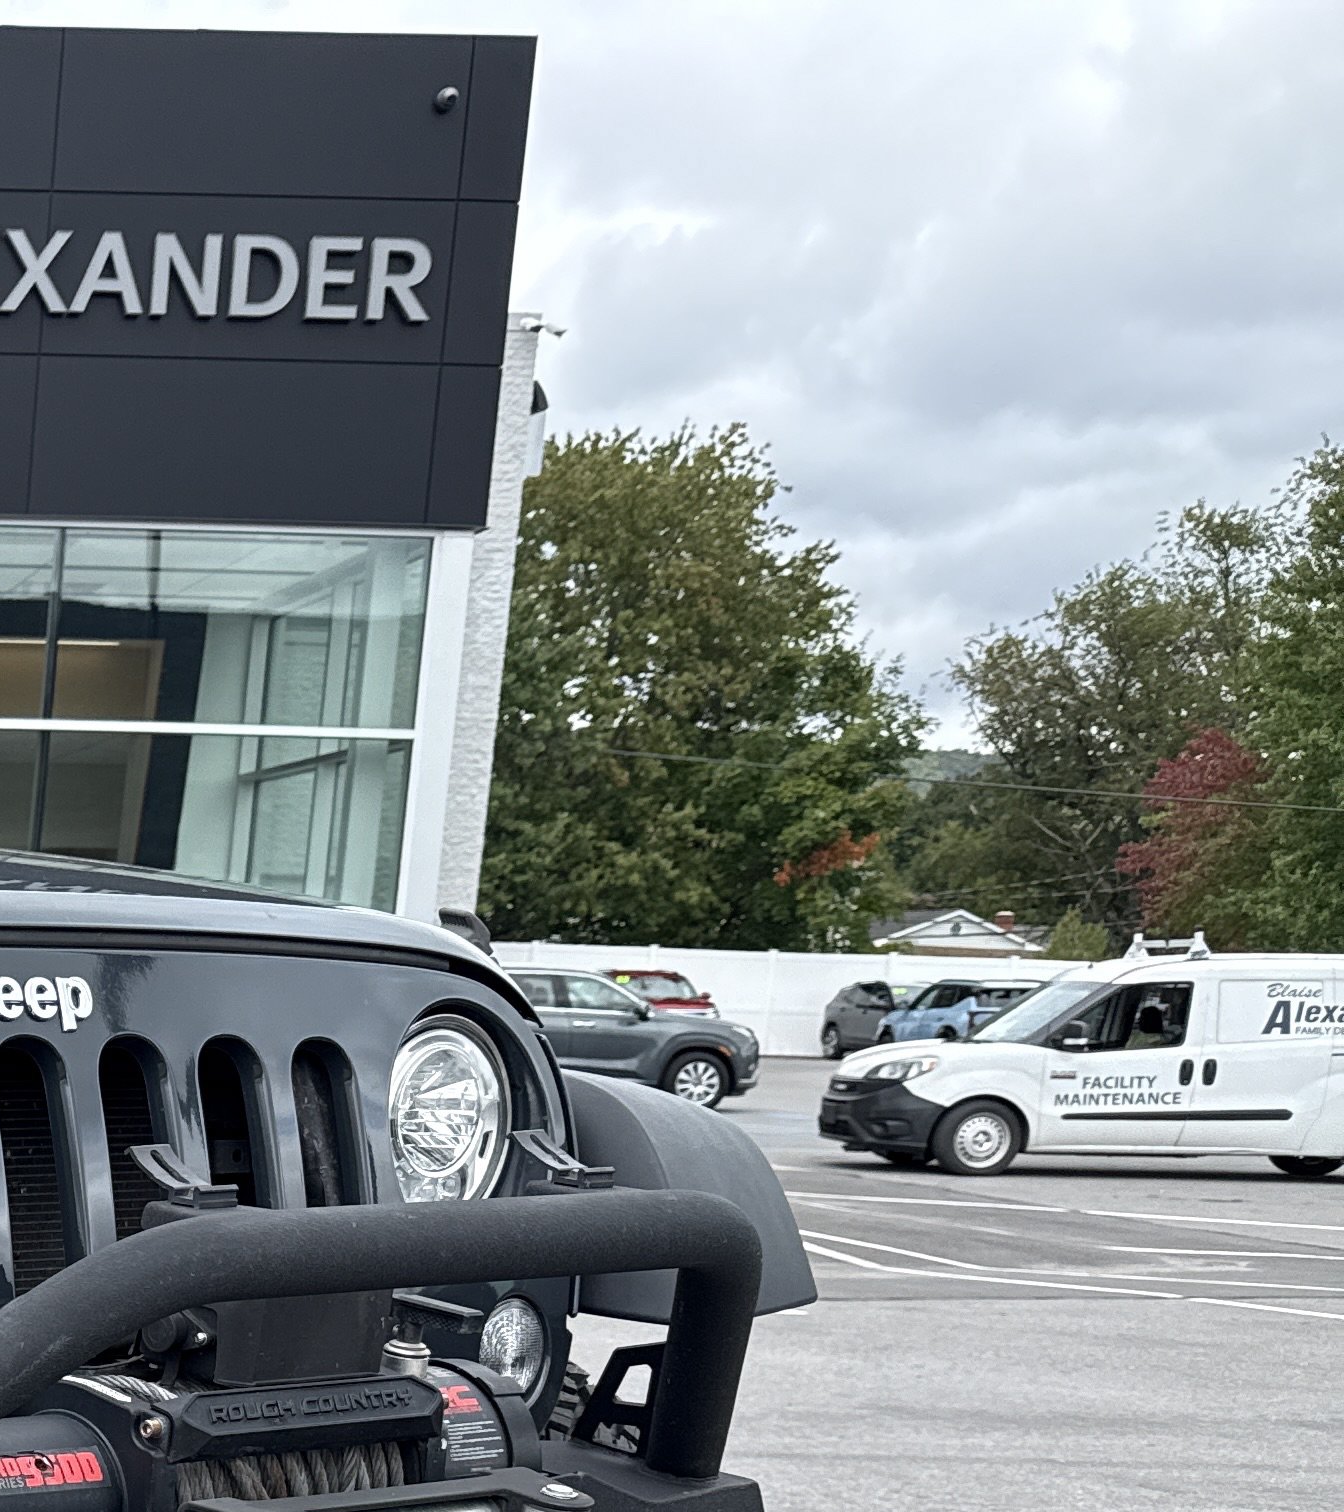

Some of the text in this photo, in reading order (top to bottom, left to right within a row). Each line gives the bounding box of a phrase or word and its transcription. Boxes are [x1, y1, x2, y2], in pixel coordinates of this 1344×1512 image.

[1267, 983, 1323, 998] Blaise
[1081, 1075, 1158, 1090] FACILITY
[1053, 1092, 1183, 1107] MAINTENANCE
[209, 1386, 413, 1424] ROUGH COUNTRY
